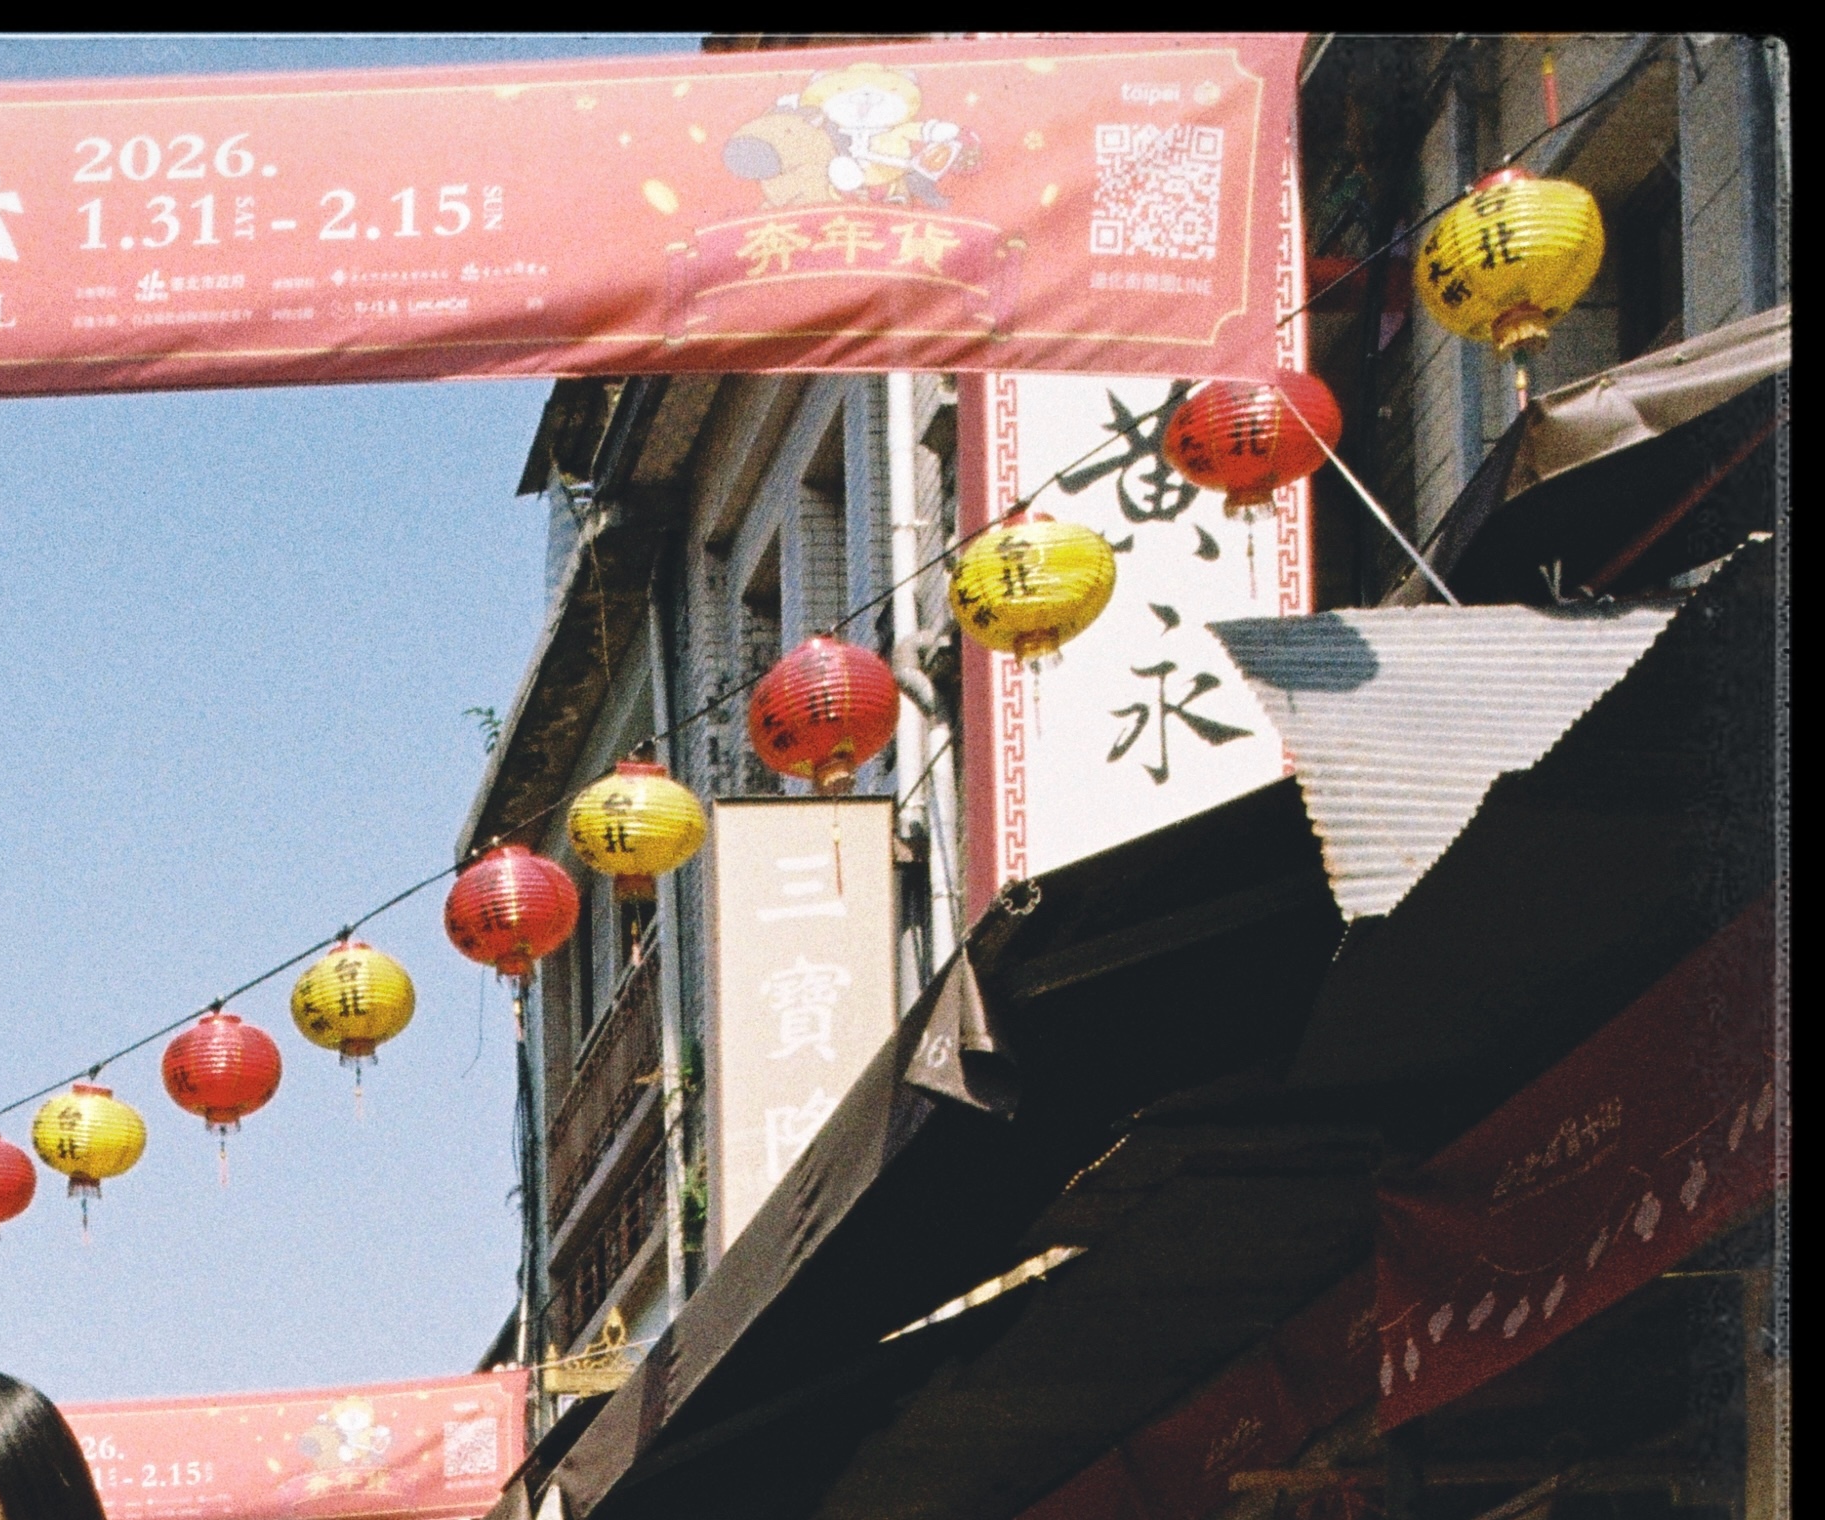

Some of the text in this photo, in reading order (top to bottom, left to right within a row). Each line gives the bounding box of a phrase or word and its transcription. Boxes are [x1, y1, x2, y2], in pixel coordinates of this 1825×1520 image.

[73, 132, 278, 183] 2026.
[78, 193, 222, 251] 1.31
[234, 195, 256, 240] SAT
[317, 183, 472, 241] 2.15
[1470, 186, 1523, 270] 台北
[995, 535, 1037, 598] 台北
[602, 793, 636, 852] 台北
[335, 959, 366, 1018] 台北
[57, 1106, 83, 1160] 台北
